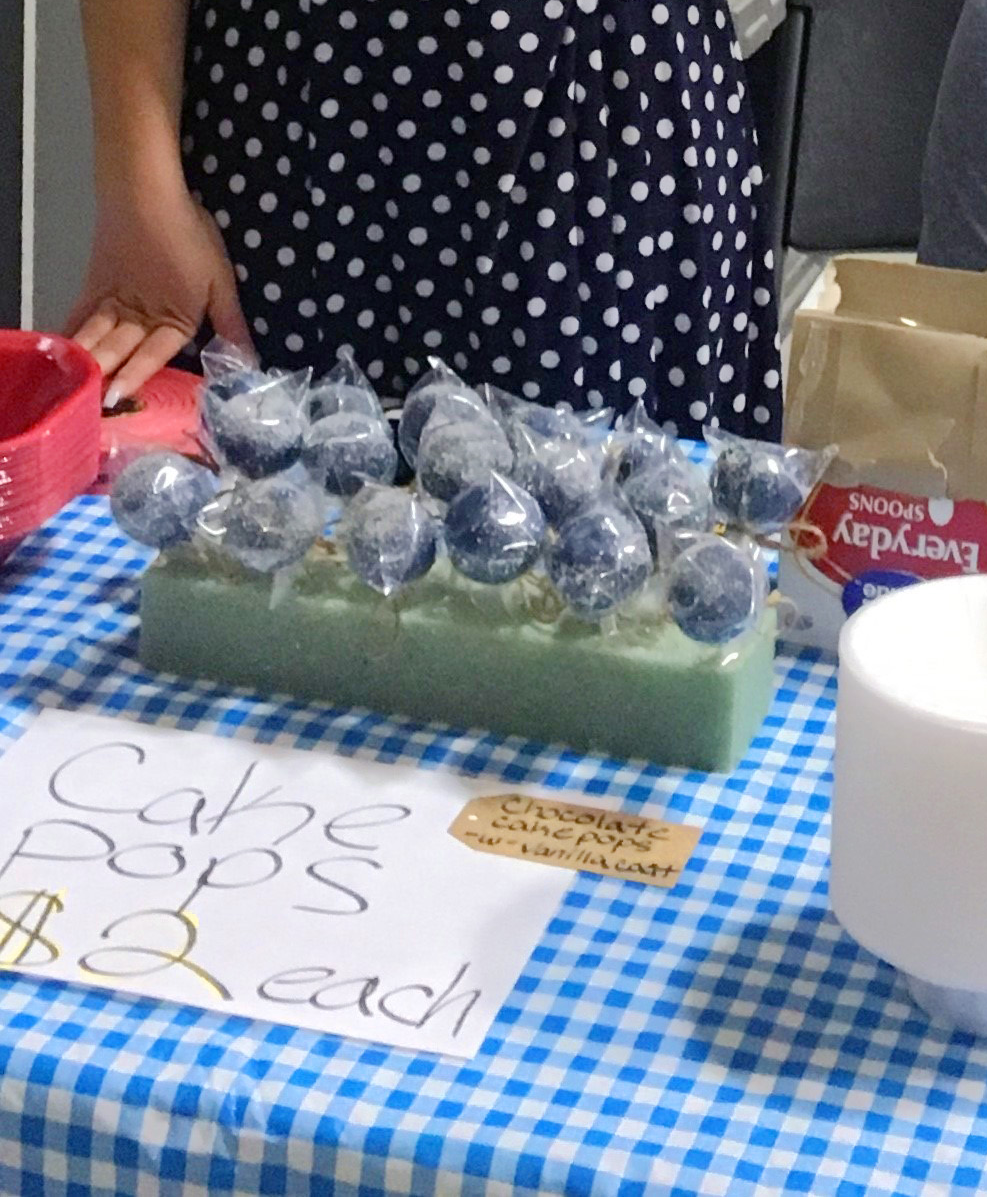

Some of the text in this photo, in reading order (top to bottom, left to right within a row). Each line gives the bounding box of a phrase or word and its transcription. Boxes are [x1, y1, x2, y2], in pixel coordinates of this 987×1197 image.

[849, 492, 924, 522] SPOONS
[832, 513, 980, 574] Everyday
[49, 742, 411, 850] Cake
[256, 962, 481, 1037] each
